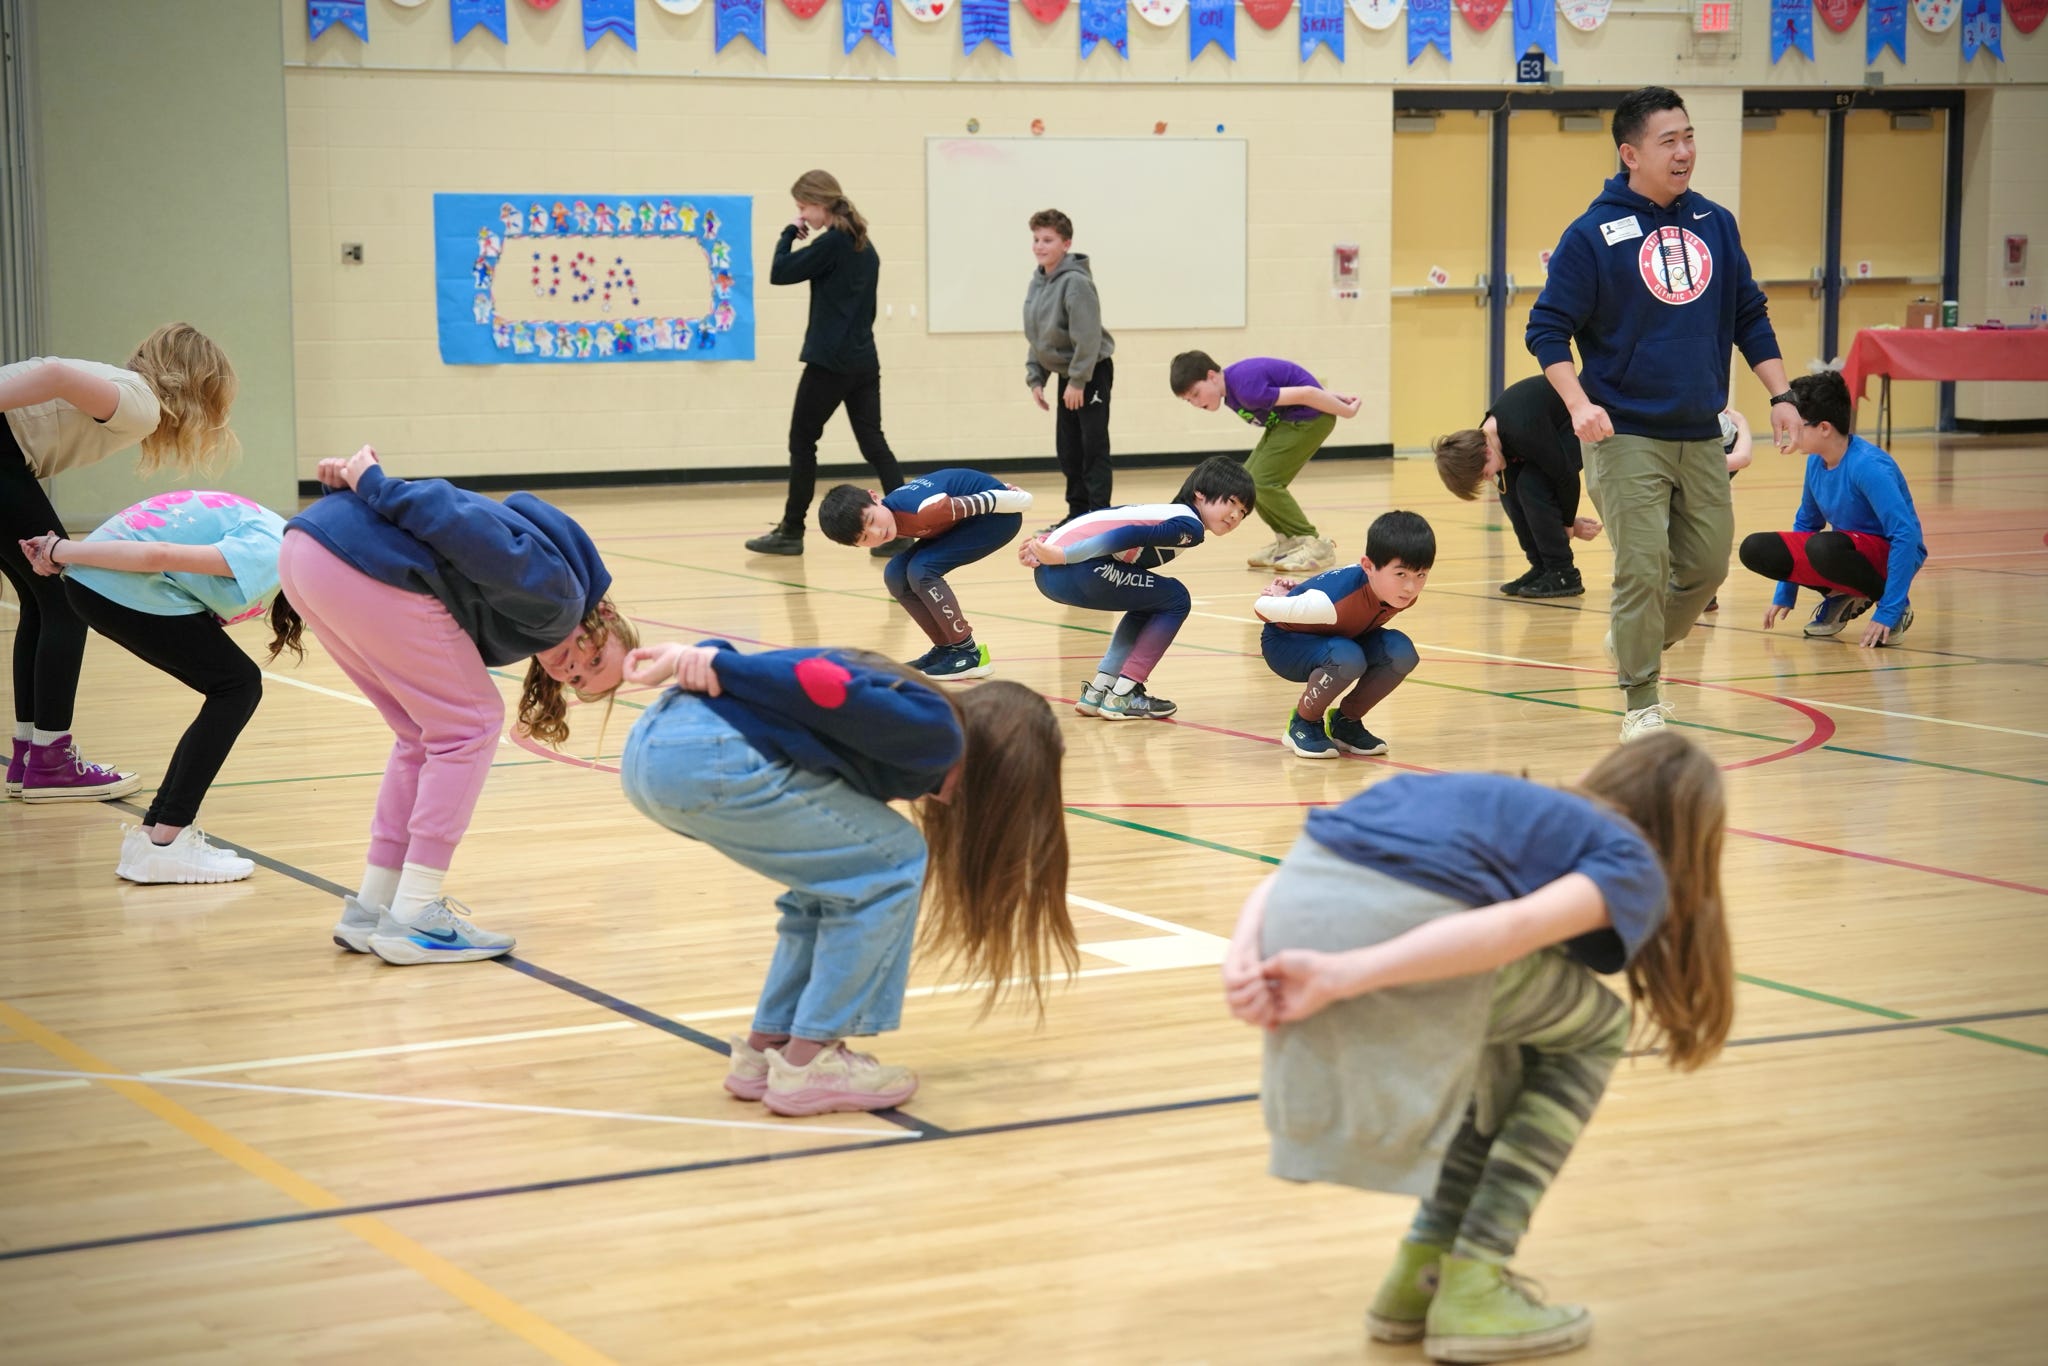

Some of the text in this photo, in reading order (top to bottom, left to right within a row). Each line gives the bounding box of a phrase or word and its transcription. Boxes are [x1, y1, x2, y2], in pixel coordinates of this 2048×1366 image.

[847, 0, 890, 28] USA
[1302, 16, 1345, 33] SKATE
[1701, 3, 1730, 31] EXIT
[1520, 60, 1542, 79] E3
[1836, 94, 1850, 105] E3
[532, 252, 641, 313] USA
[1093, 562, 1156, 588] PINNACLE
